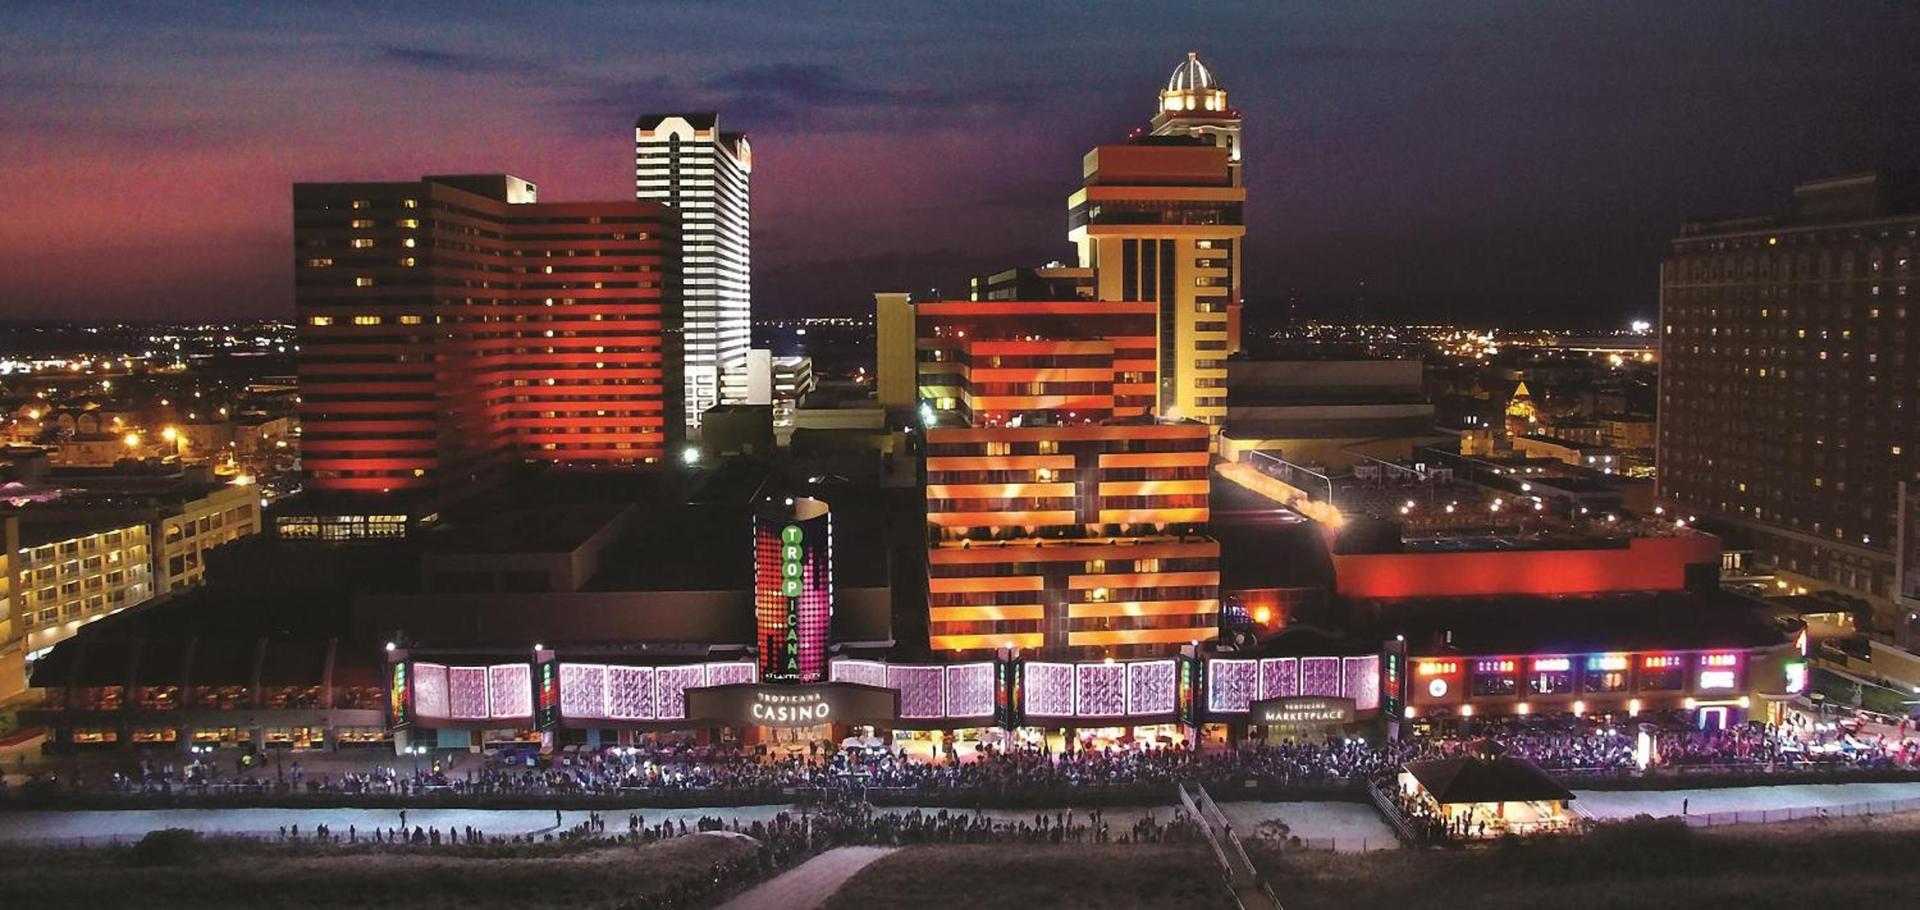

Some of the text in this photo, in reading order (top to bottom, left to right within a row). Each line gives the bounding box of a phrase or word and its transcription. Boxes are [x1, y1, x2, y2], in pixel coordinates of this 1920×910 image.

[786, 528, 798, 670] TROPICANA
[757, 692, 821, 703] TROPICANA
[753, 702, 829, 721] CASINO
[1265, 710, 1345, 721] MARKETPLACE
